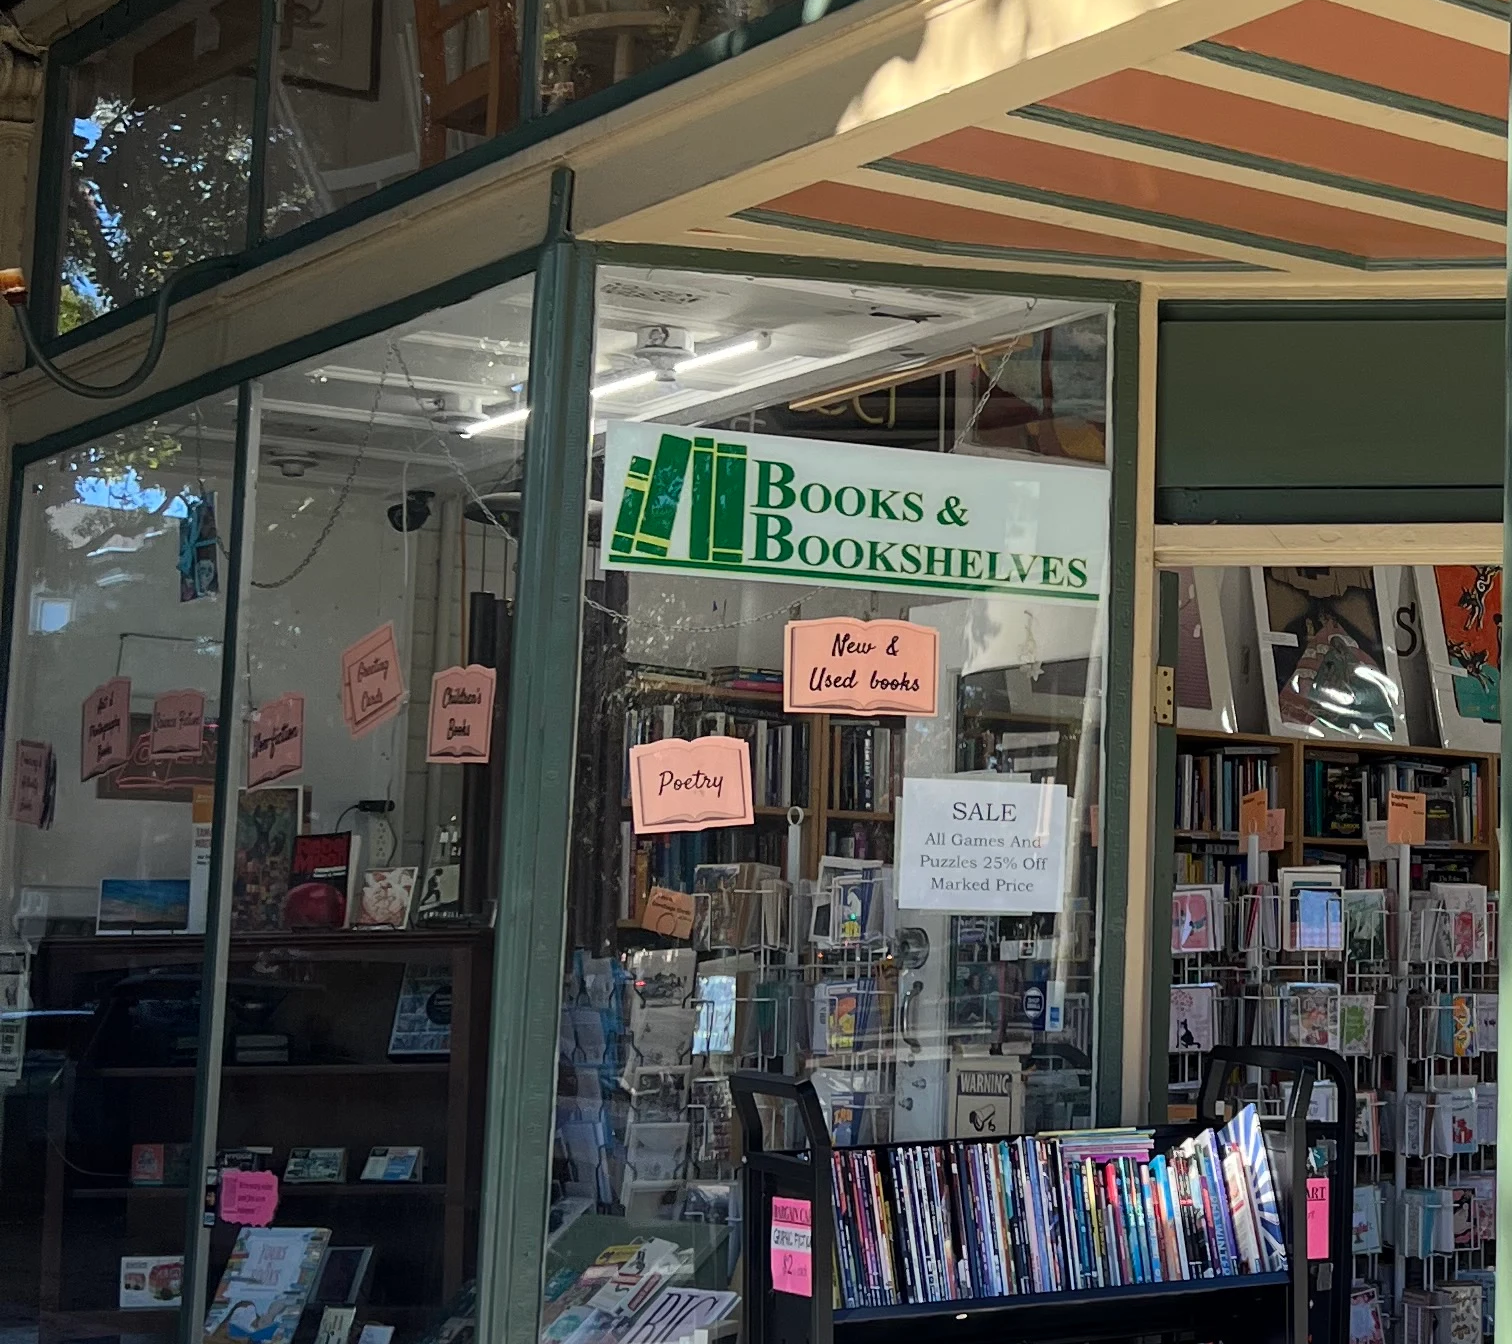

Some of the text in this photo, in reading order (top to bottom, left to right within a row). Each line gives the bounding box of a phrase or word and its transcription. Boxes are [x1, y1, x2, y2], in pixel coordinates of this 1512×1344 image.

[936, 496, 970, 527] &
[831, 633, 900, 659] New &
[809, 668, 921, 693] Used books
[659, 769, 724, 798] Poetry
[952, 802, 1017, 822] SALE
[924, 833, 1042, 849] All Games And
[919, 854, 1049, 871] Puzzles 25% Off
[930, 877, 1035, 893] Marked Price
[959, 1072, 1011, 1094] WARNING
[1213, 1223, 1231, 1276] WINTER
